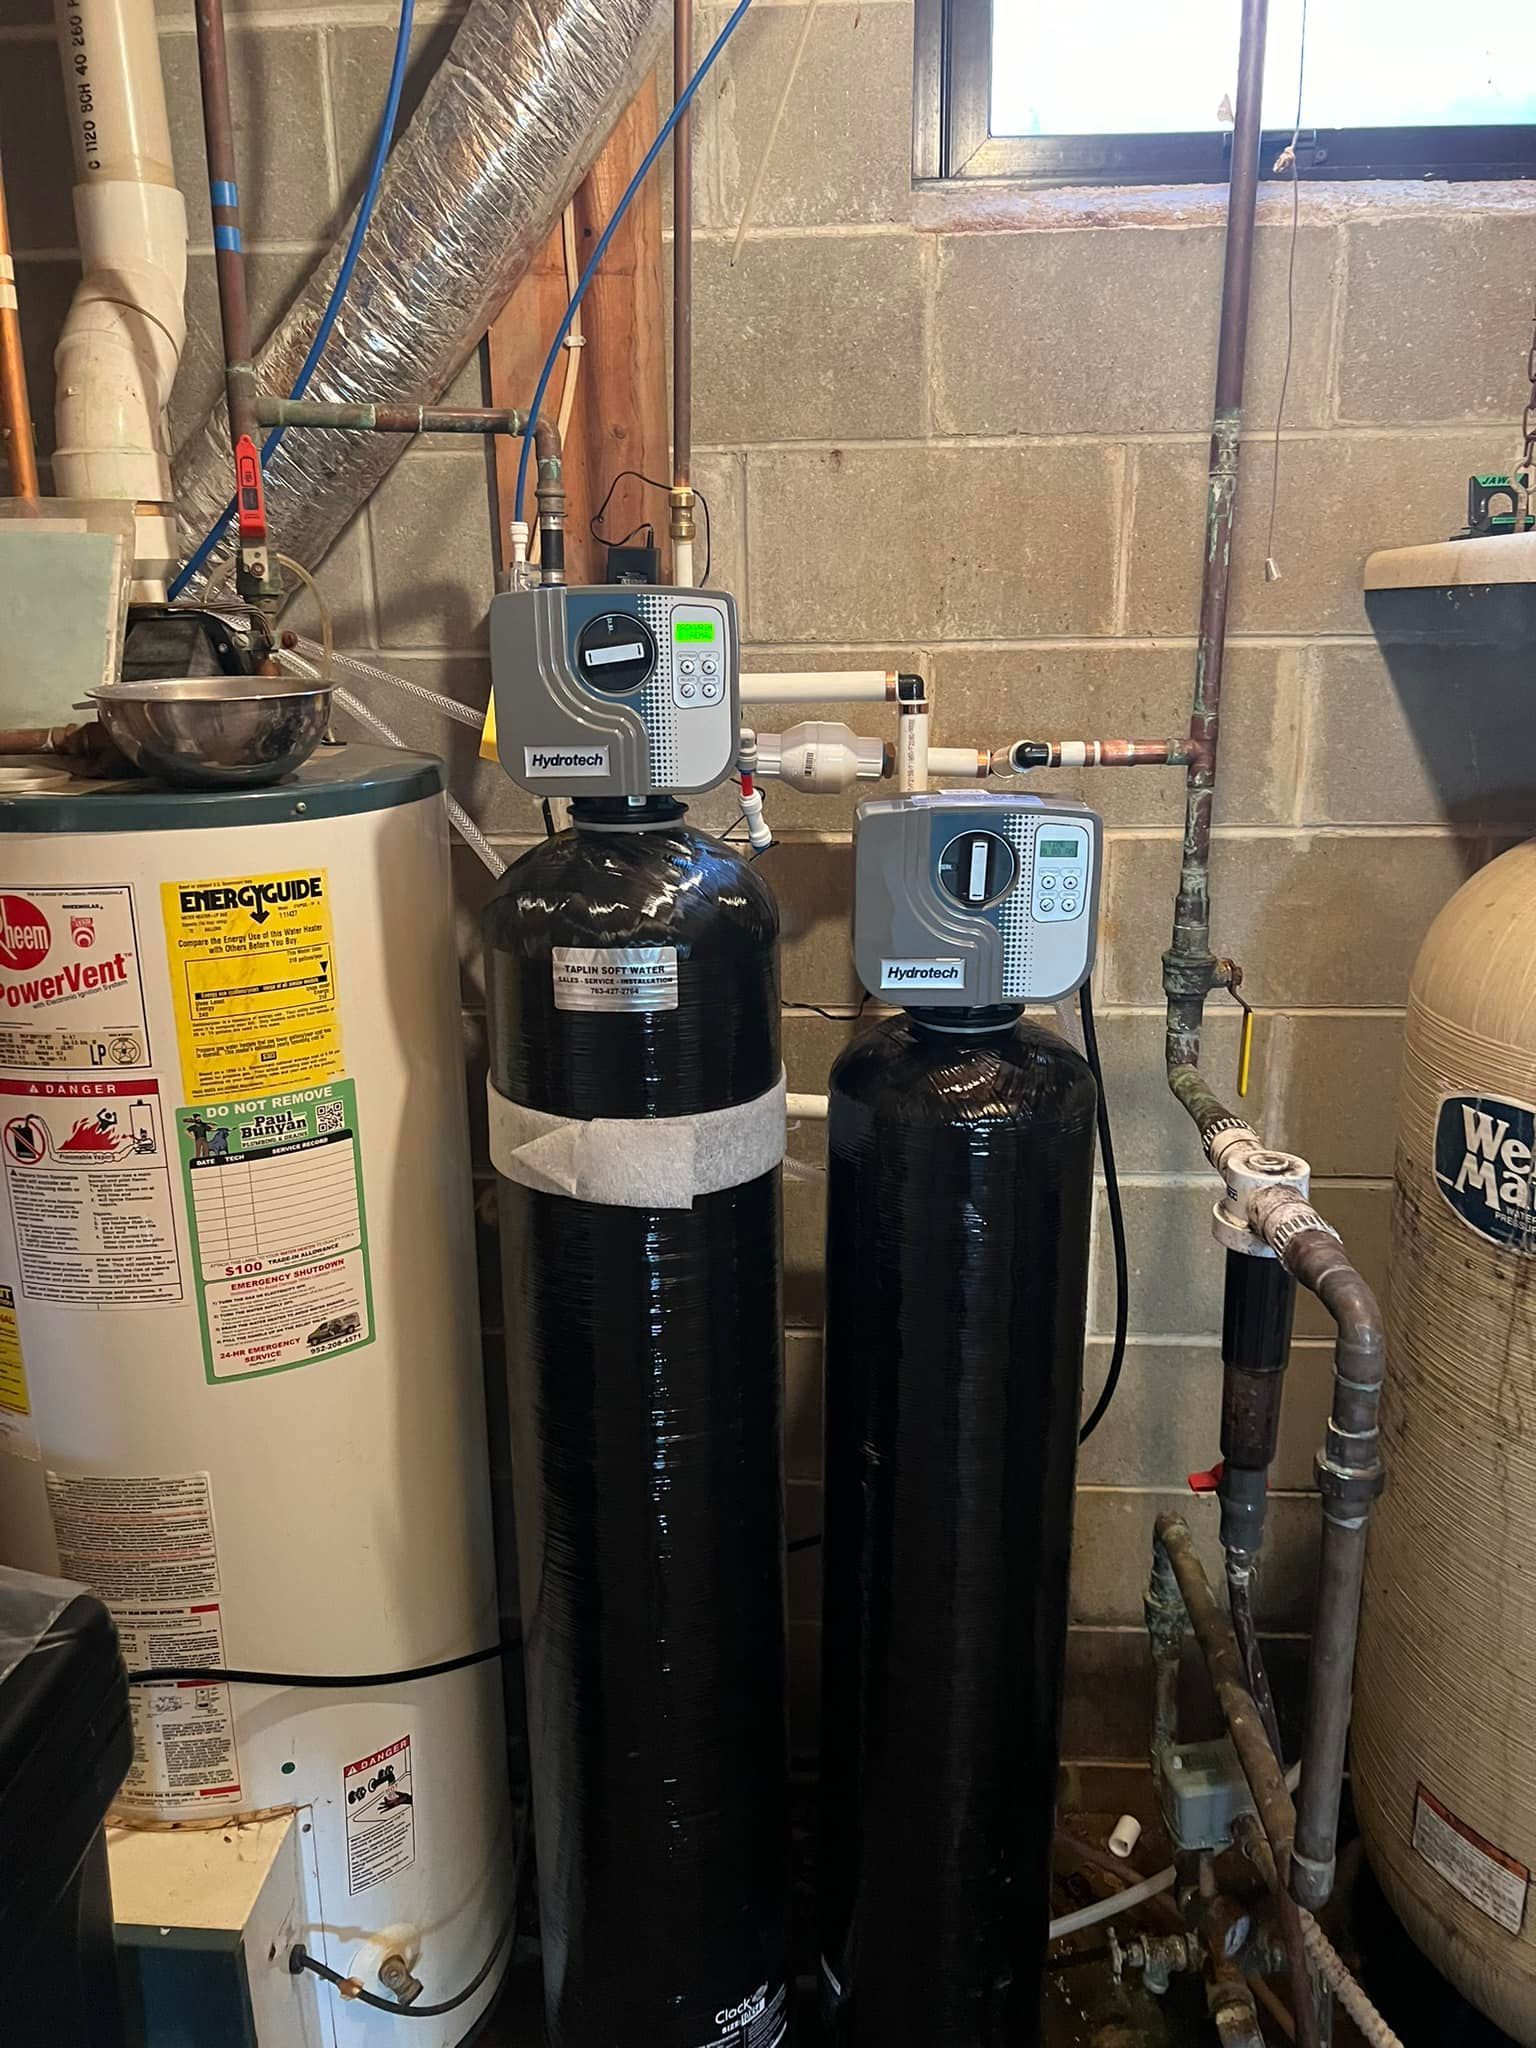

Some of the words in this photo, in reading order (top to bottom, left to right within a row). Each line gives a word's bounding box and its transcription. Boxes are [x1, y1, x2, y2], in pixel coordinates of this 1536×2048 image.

[69, 15, 85, 47] 260
[74, 54, 88, 76] 40
[83, 120, 98, 152] 1120
[88, 160, 100, 170] C
[1482, 476, 1512, 485] JAW
[532, 753, 603, 769] Hydrotech
[178, 939, 209, 949] Compare
[210, 936, 222, 944] the
[223, 934, 246, 944] Energy
[248, 931, 261, 940] Use
[262, 930, 269, 938] of
[270, 928, 282, 937] this
[284, 926, 302, 936] Water
[304, 924, 322, 933] Heater
[209, 946, 224, 954] with
[225, 943, 247, 953] Others
[248, 940, 269, 950] Before
[271, 938, 284, 947] You
[286, 937, 297, 946] Buy
[564, 965, 599, 975] TAPLIN
[601, 966, 627, 975] SOFT
[629, 965, 665, 974] WATER
[888, 966, 959, 981] Hydrotech
[621, 977, 673, 985] INSTALLATION
[89, 1044, 106, 1065] LP
[46, 1084, 117, 1094] DANGER
[206, 1106, 229, 1119] DO
[234, 1100, 267, 1114] NOT
[271, 1086, 333, 1108] REMOVE
[241, 1119, 307, 1139] Bunyan
[254, 1111, 293, 1126] Paul
[196, 1158, 215, 1166] DATE
[225, 1154, 245, 1162] TECH
[272, 1144, 300, 1154] SERVICE
[302, 1137, 329, 1148] RECORD
[1454, 1151, 1536, 1212] Ma
[268, 1253, 300, 1265] TRADE-IN
[301, 1242, 339, 1258] ALLOWANCE
[225, 1261, 263, 1277] $100
[231, 1273, 291, 1291] EMERGENCY
[294, 1258, 344, 1278] SHUTDOWN
[220, 1349, 246, 1360] 24-HR
[247, 1337, 301, 1355] EMERGENCY
[245, 1350, 282, 1364] SERVICE
[361, 1739, 408, 1770] DANGER
[715, 1998, 752, 2024] Clack
